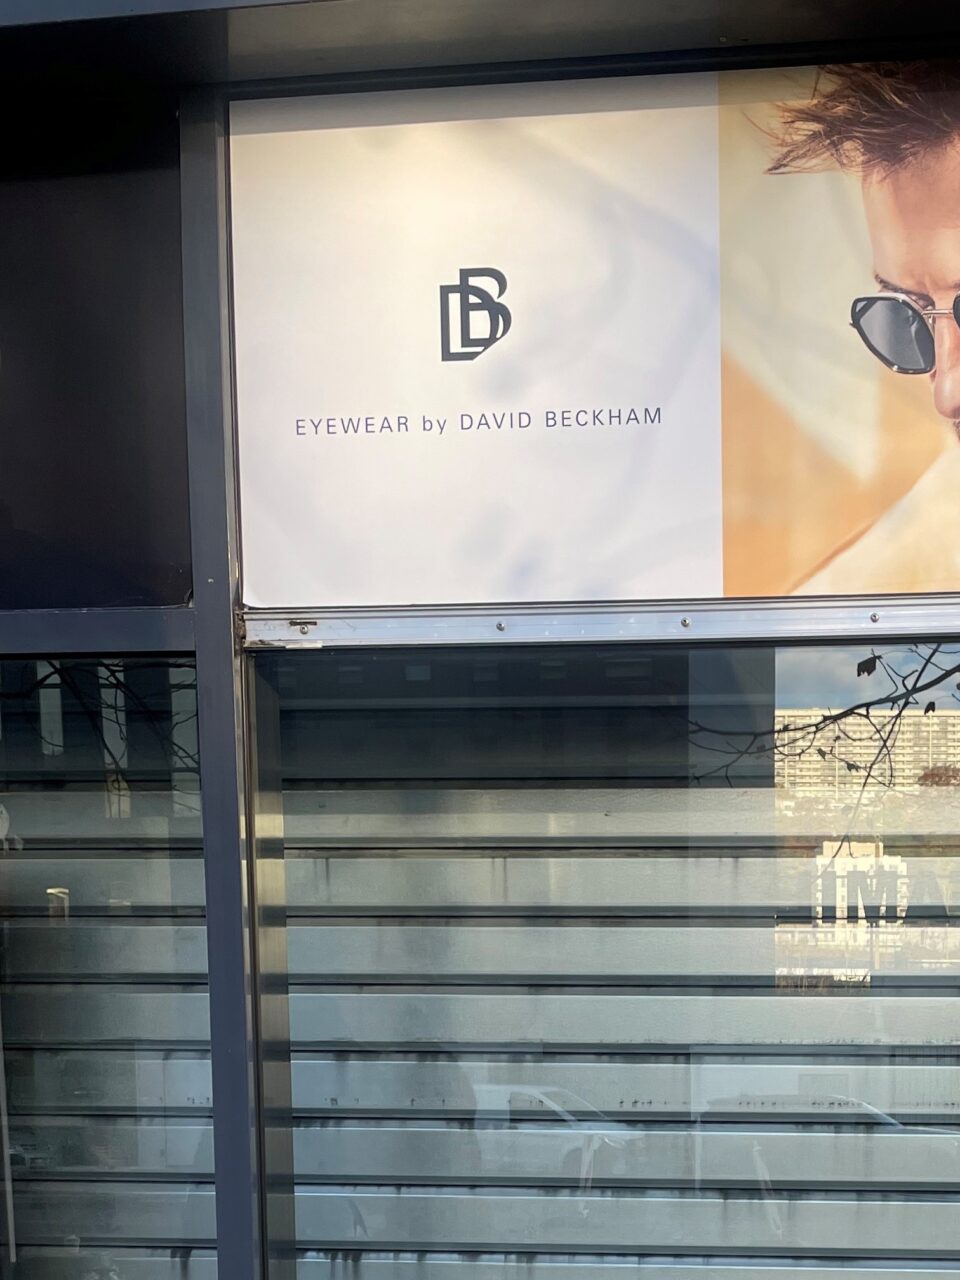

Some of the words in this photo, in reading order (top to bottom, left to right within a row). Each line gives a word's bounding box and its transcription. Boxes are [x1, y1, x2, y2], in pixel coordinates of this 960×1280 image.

[295, 415, 410, 436] EYEWEAR
[422, 415, 447, 435] by
[459, 411, 532, 432] DAVID
[545, 406, 663, 428] BECKHAM
